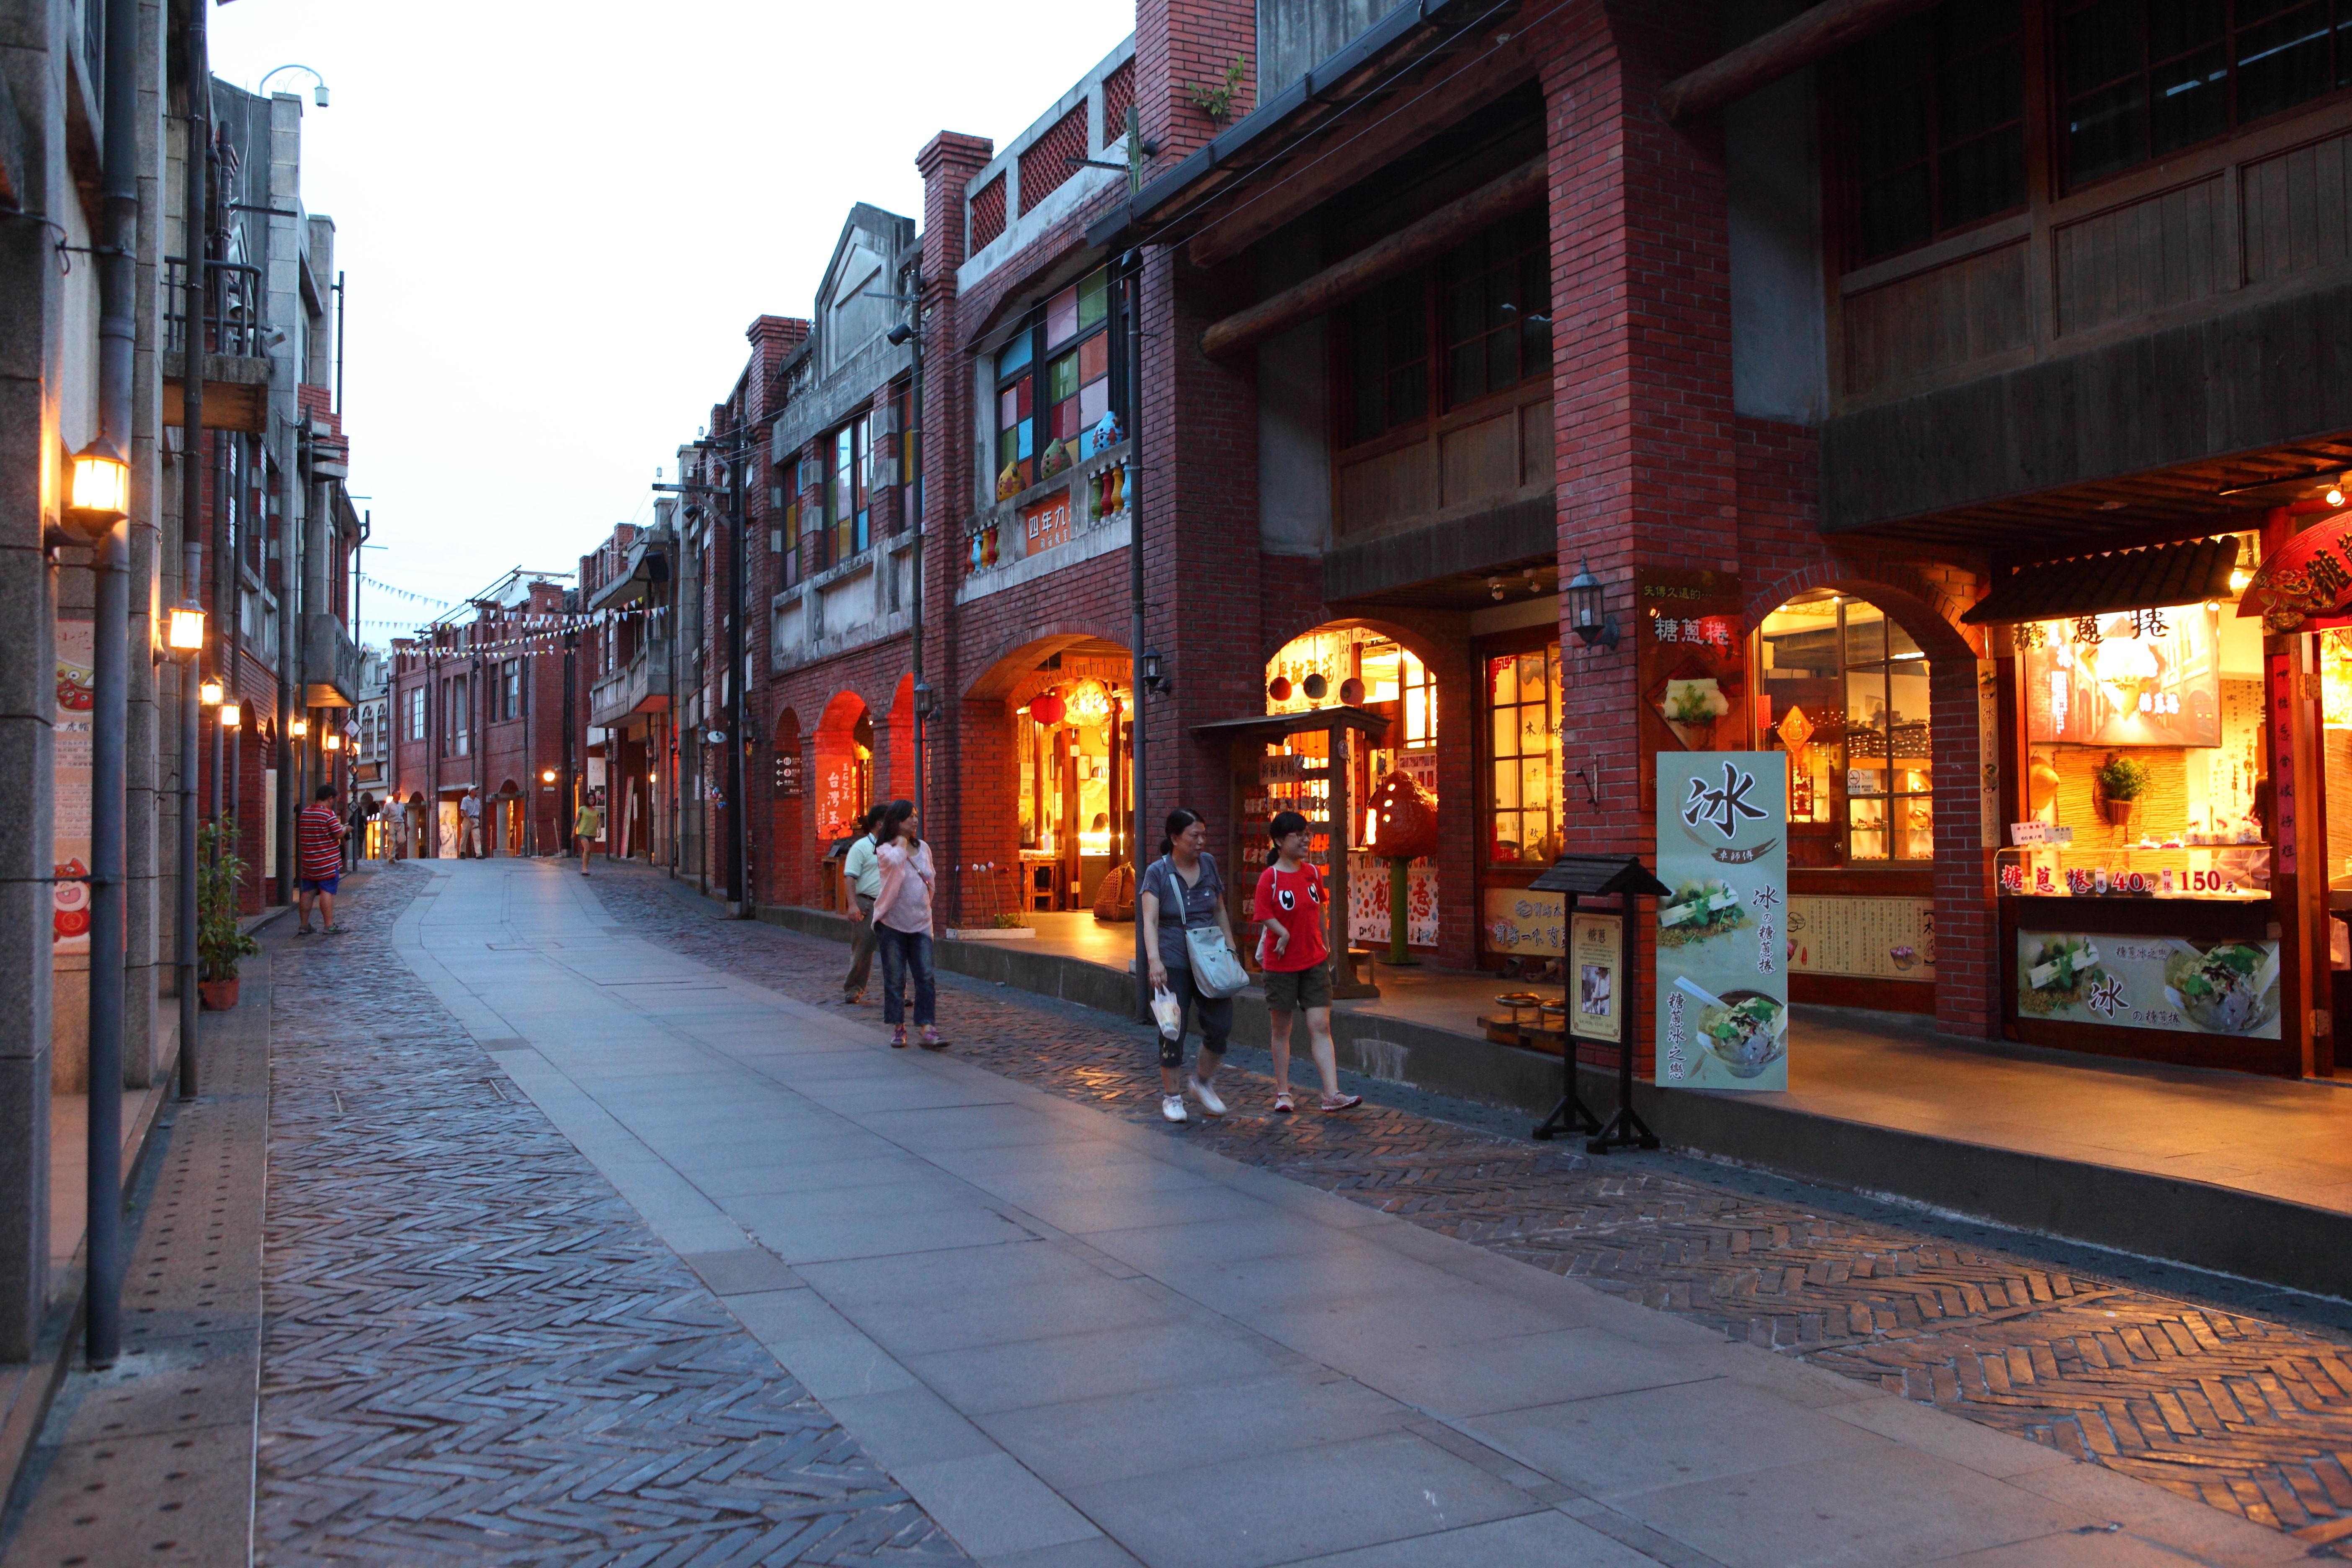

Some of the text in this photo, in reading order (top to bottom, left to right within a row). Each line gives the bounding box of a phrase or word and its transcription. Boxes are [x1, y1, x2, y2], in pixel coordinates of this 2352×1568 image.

[1029, 504, 1078, 539] 四年九
[827, 771, 840, 825] 台灣玉
[1682, 761, 1769, 839] 冰
[2001, 865, 2092, 894] 糖蔥捲
[1534, 902, 1564, 918] 罰站木
[1752, 883, 1782, 974] 冰の糖蔥捲
[2089, 975, 2130, 1018] 冰
[1669, 993, 1687, 1080] 糖蔥冰之戀
